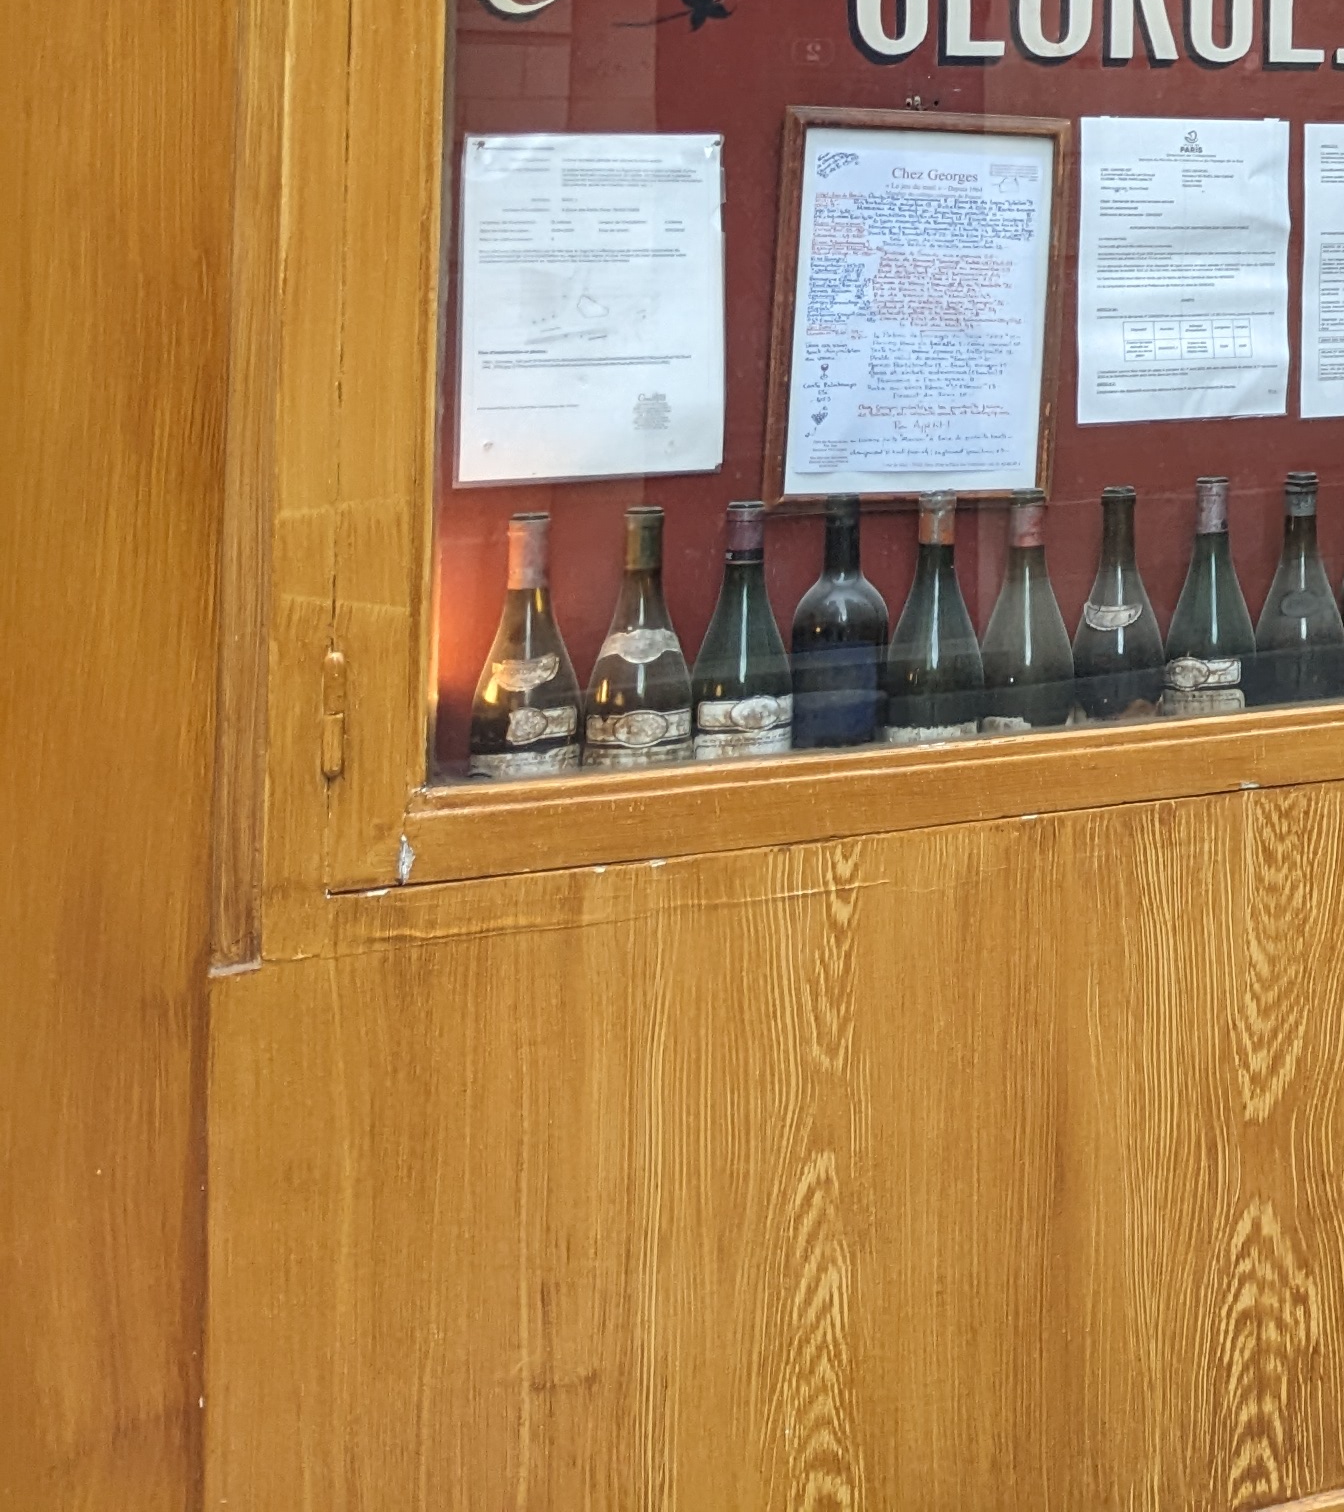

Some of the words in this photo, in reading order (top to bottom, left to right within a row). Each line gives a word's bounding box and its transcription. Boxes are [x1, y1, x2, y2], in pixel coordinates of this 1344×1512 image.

[1180, 146, 1203, 154] PARIS
[891, 166, 924, 180] Chez
[927, 168, 979, 185] Georges
